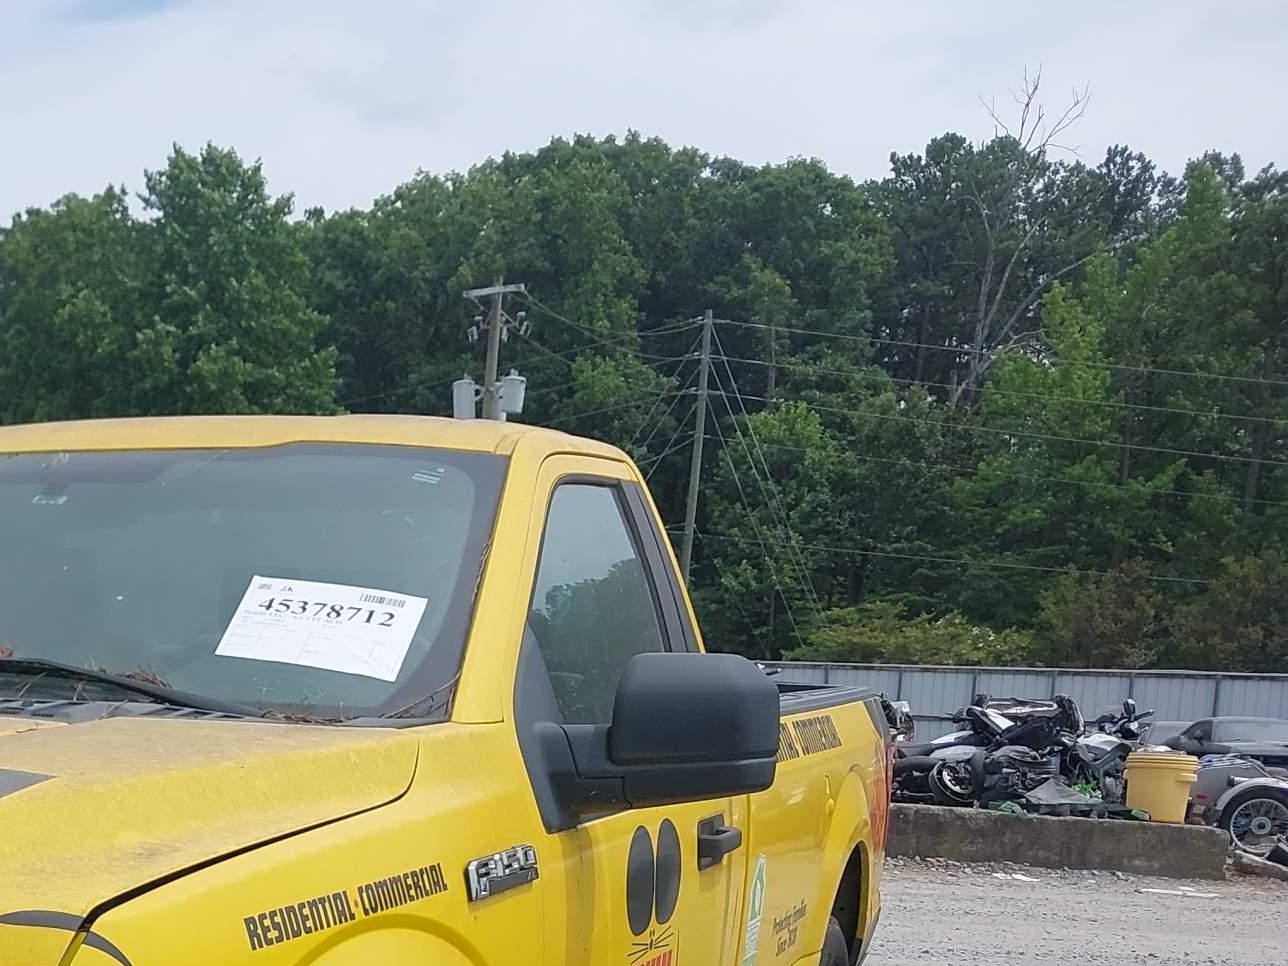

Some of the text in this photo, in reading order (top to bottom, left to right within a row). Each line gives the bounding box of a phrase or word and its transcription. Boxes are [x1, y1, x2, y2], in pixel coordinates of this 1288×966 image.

[258, 597, 396, 628] 45378712
[243, 862, 448, 951] RESIDENTIAL COMMERCIAL
